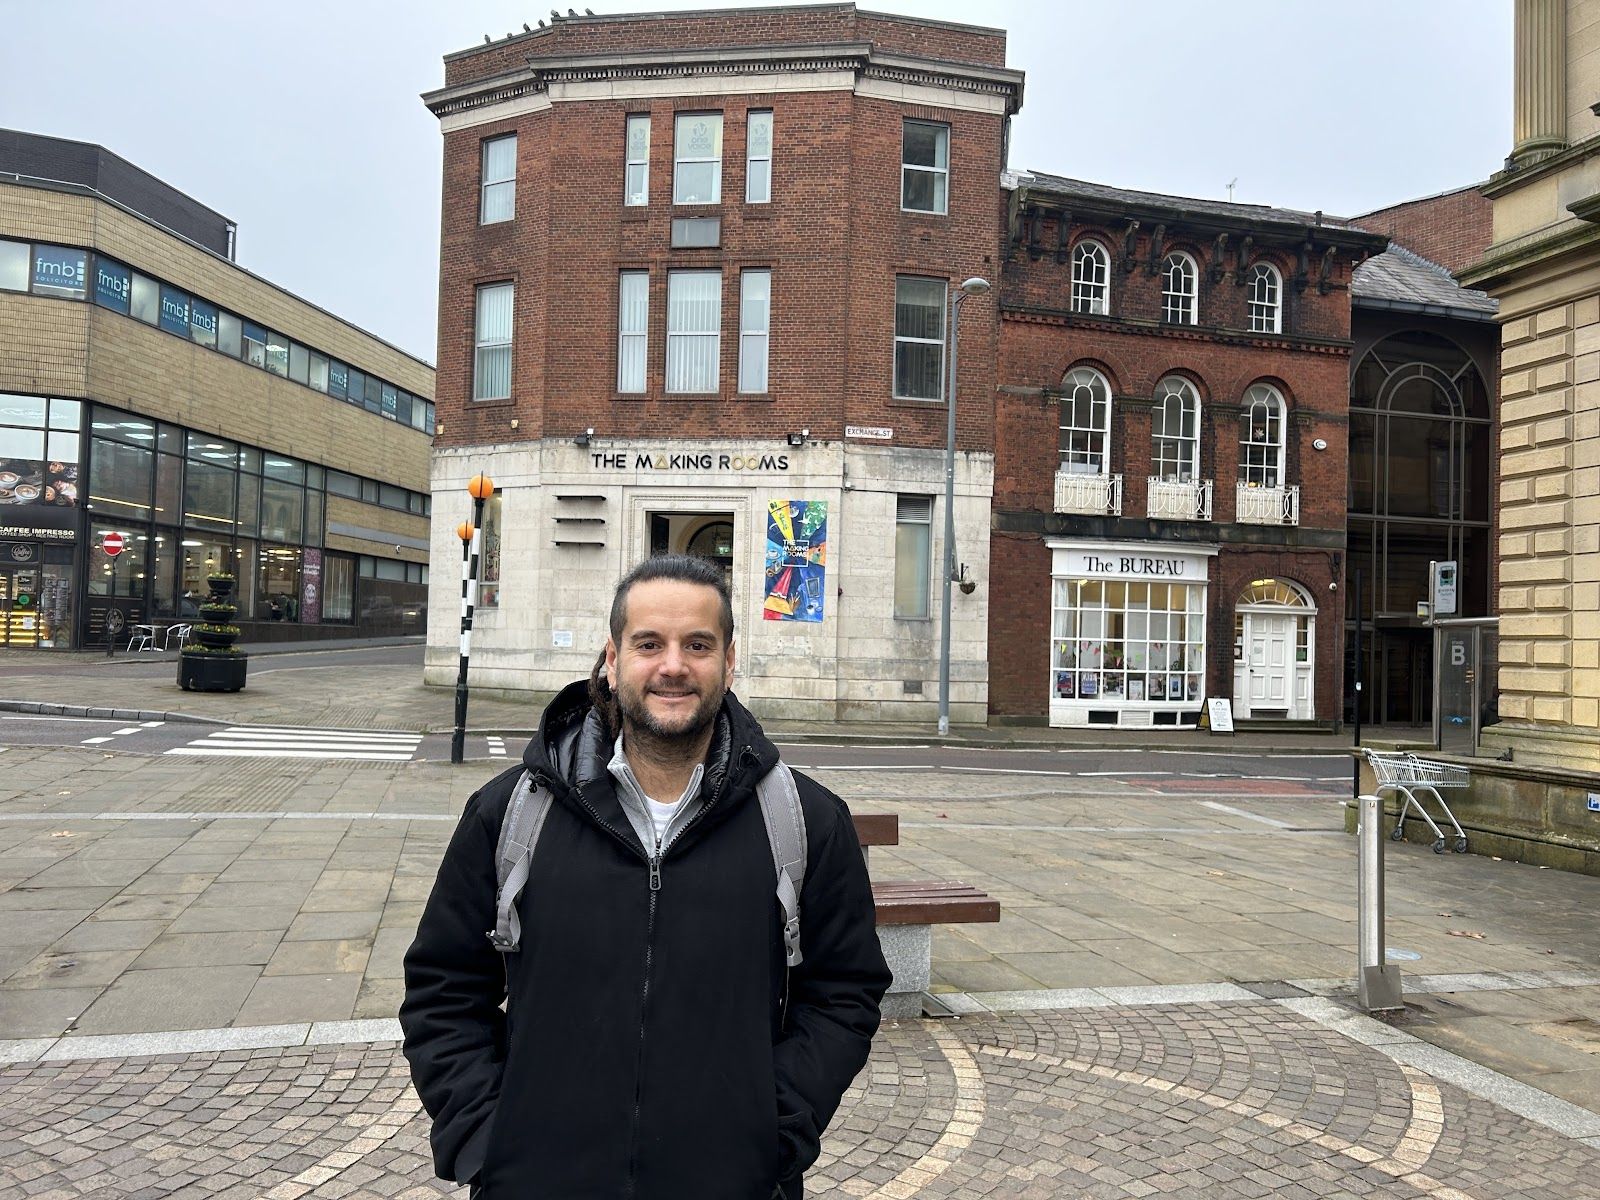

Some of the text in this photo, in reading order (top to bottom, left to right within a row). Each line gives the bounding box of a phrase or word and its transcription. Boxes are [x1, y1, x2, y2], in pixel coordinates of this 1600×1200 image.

[35, 258, 75, 277] fmb
[35, 276, 83, 287] SOLICITORS
[98, 269, 122, 292] fmb
[162, 297, 184, 318] fmb
[192, 309, 212, 329] fmb
[330, 369, 344, 385] fmb
[591, 453, 789, 470] THE MAKING ROOMS
[31, 528, 75, 536] IMPRESSO
[1083, 556, 1184, 575] The BUREAU
[1451, 645, 1466, 666] B
